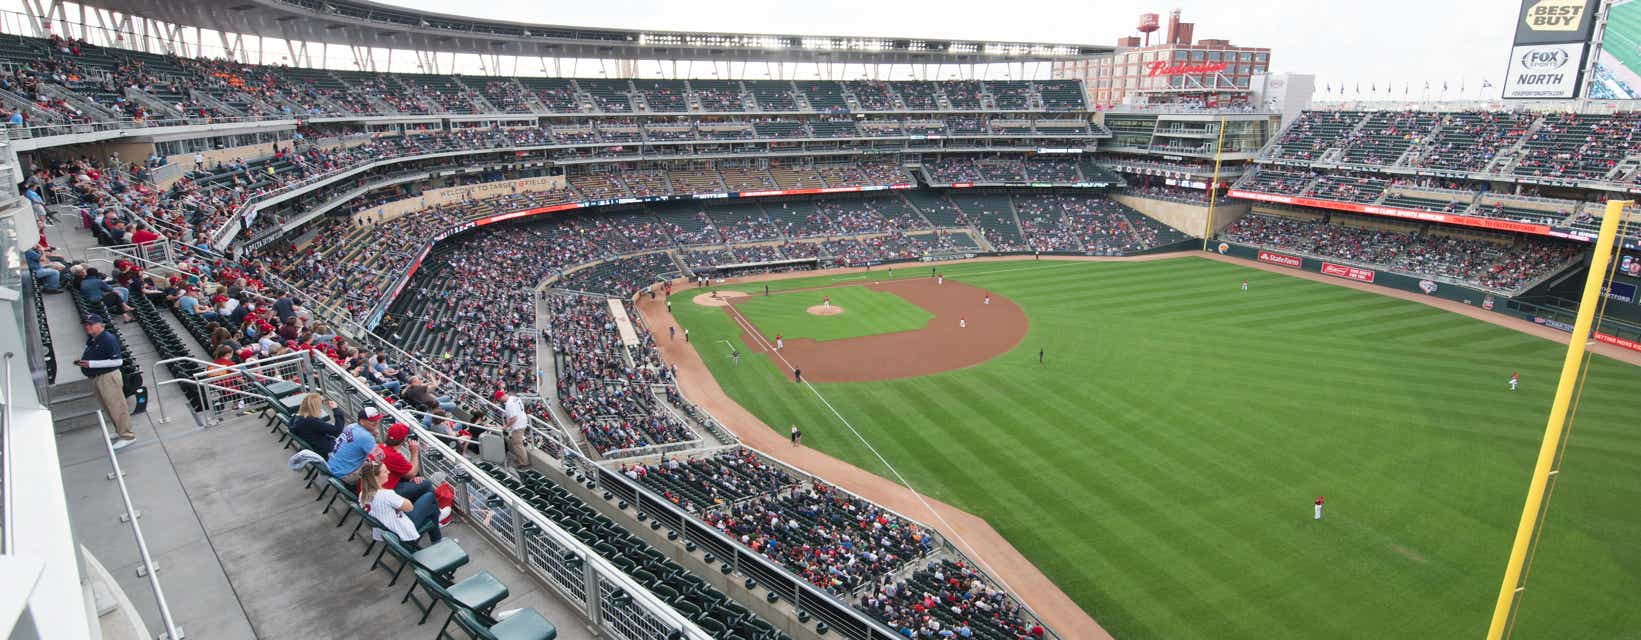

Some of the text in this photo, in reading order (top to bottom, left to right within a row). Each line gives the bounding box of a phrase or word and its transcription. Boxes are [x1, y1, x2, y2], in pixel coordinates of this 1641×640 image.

[1534, 5, 1583, 15] BEST
[1532, 16, 1575, 26] BUY
[1531, 51, 1559, 63] FOX
[1145, 60, 1227, 78] Budweiser
[1517, 73, 1564, 85] NORTH
[440, 187, 475, 197] WELCOME
[489, 181, 517, 190] TARGET
[525, 178, 546, 186] FIELD
